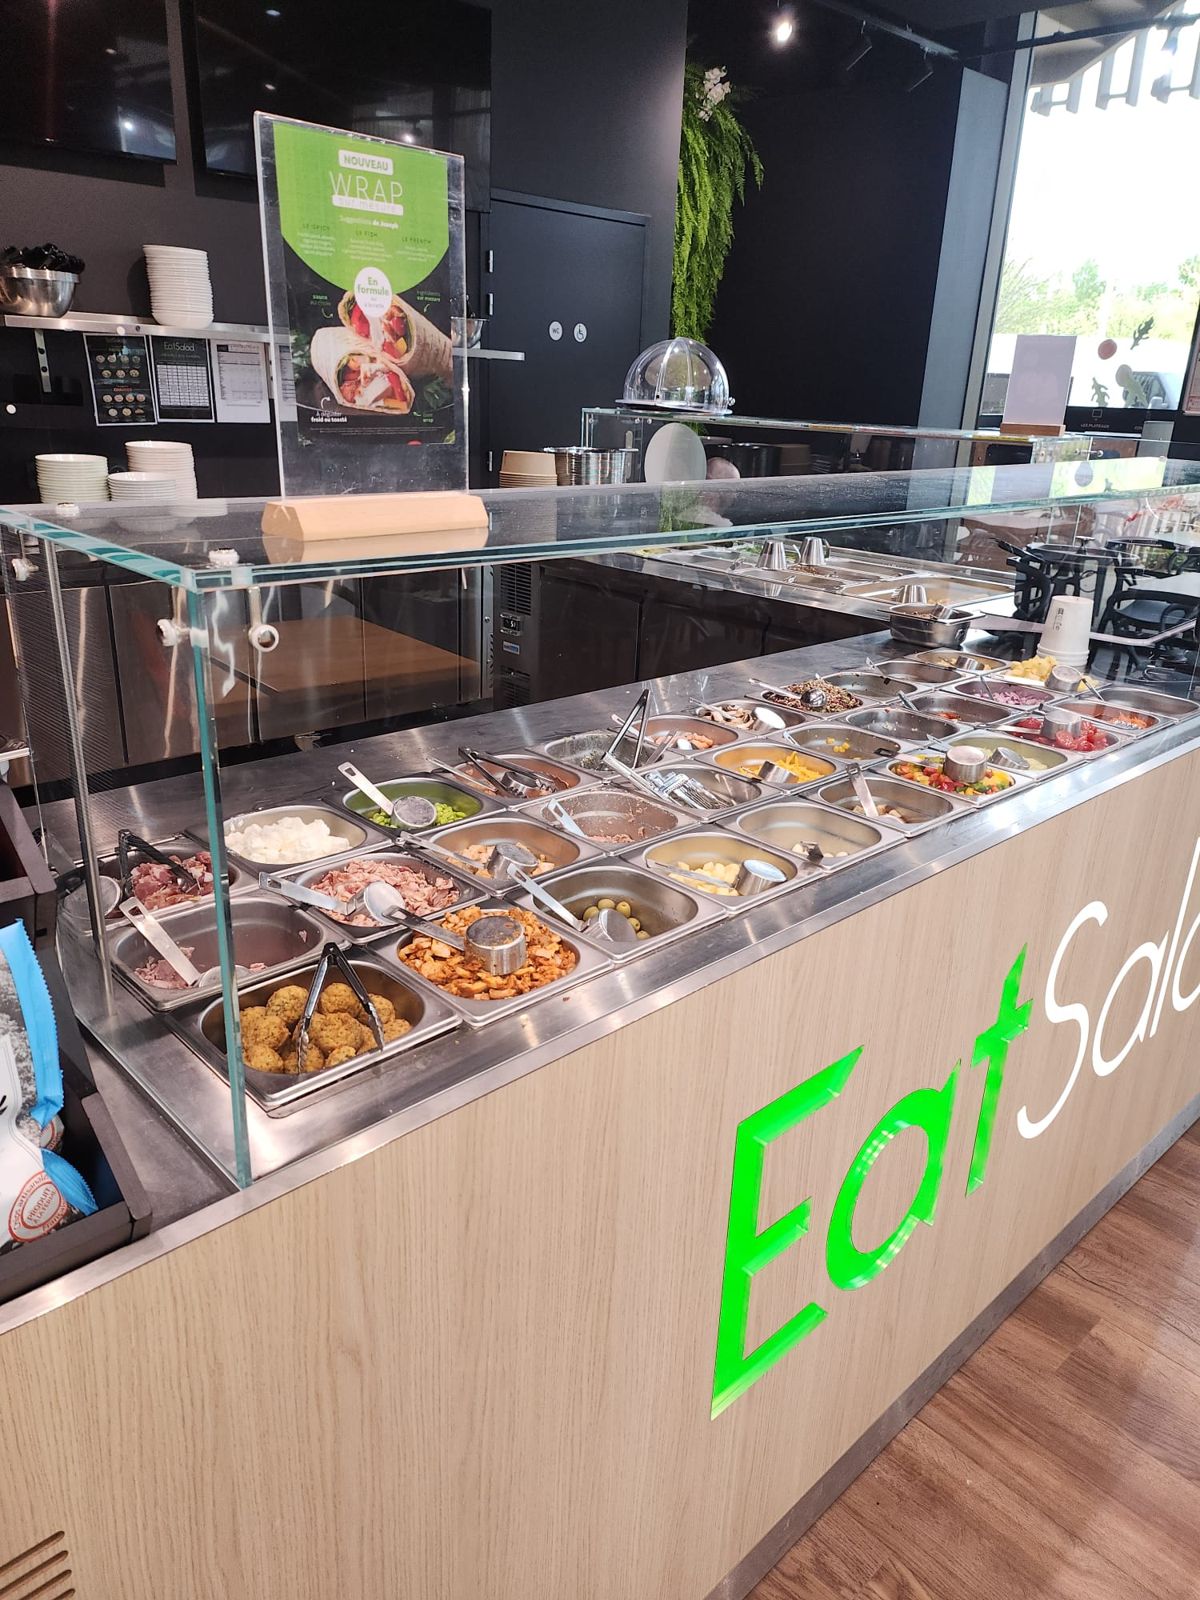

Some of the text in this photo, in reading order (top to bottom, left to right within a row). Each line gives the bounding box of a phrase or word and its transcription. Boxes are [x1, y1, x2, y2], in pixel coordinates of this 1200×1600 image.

[343, 154, 389, 171] NOUVEAU
[328, 170, 404, 205] WRAP
[357, 283, 390, 296] formule
[367, 276, 379, 286] En
[27, 1187, 51, 1221] PRODUIT
